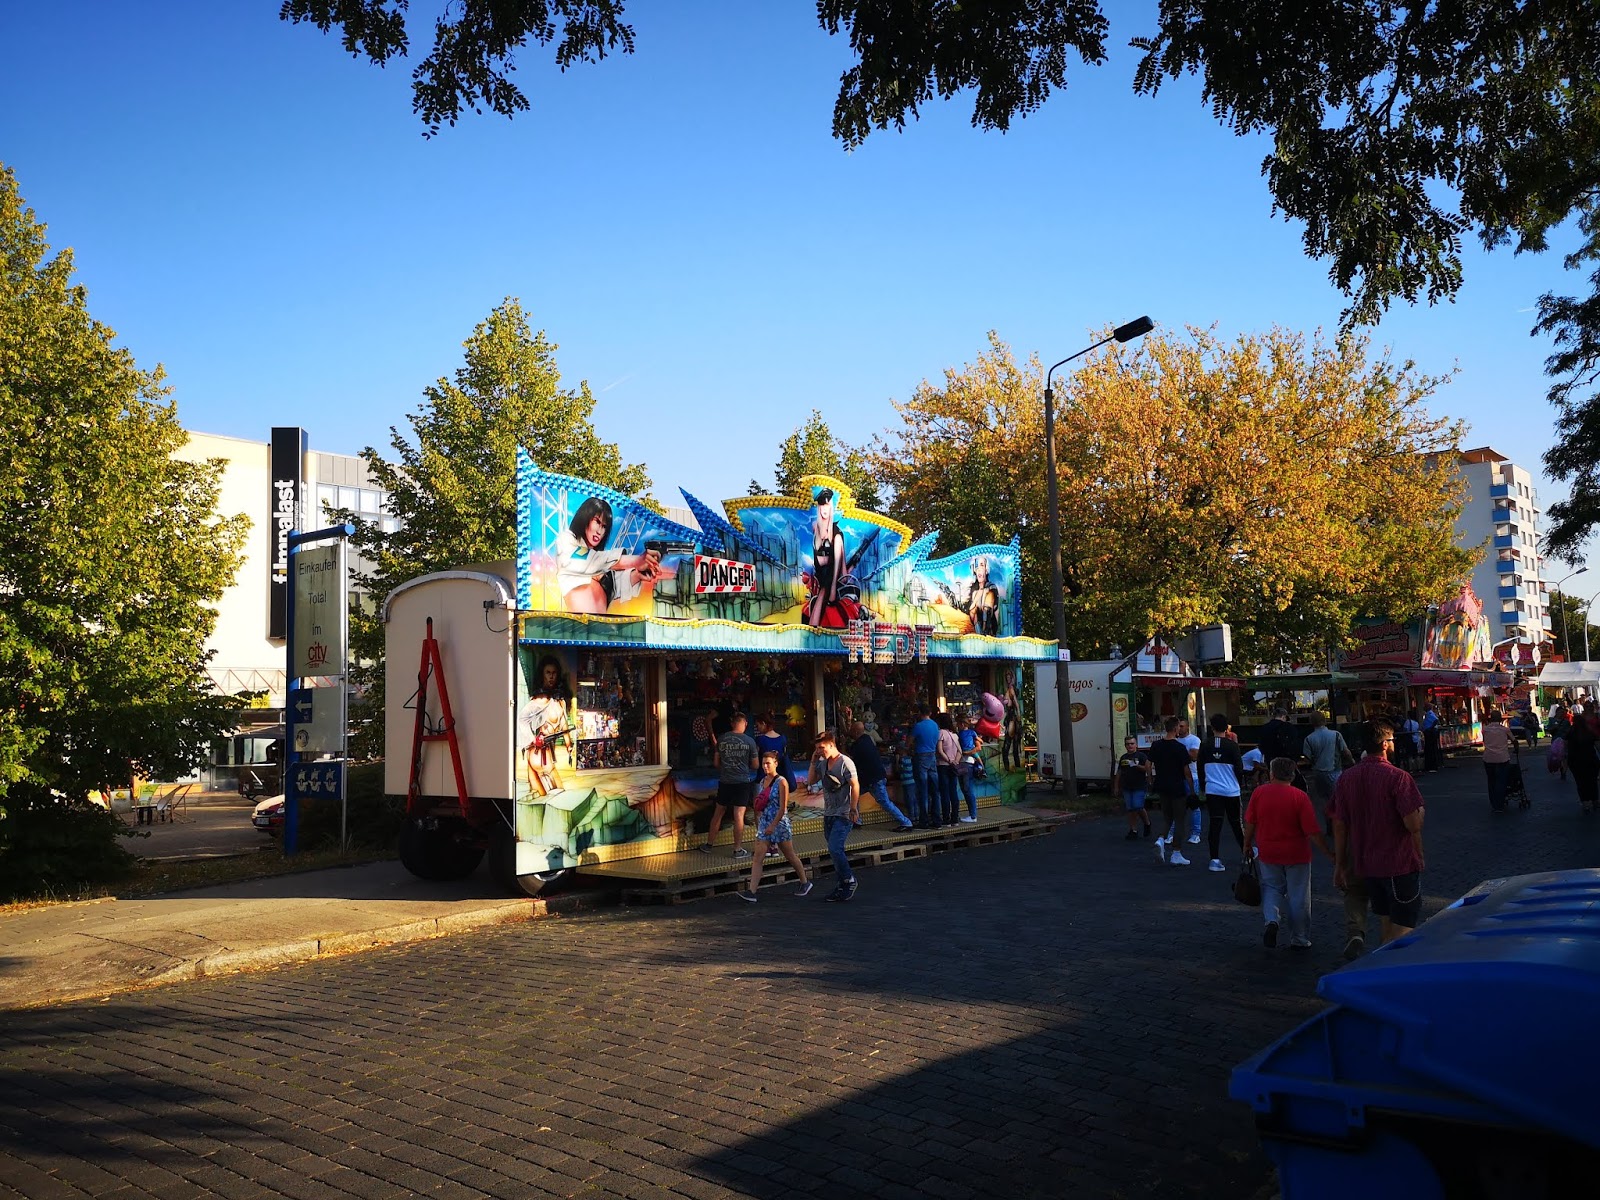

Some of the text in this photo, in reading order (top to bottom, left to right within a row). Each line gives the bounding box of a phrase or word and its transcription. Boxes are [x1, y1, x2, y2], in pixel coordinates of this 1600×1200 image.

[299, 559, 337, 575] Einkaufen
[700, 561, 753, 587] DANGER!
[308, 590, 327, 605] Total
[312, 623, 322, 636] im
[308, 641, 328, 664] city
[1053, 678, 1094, 693] ngos
[1166, 678, 1192, 687] Langos
